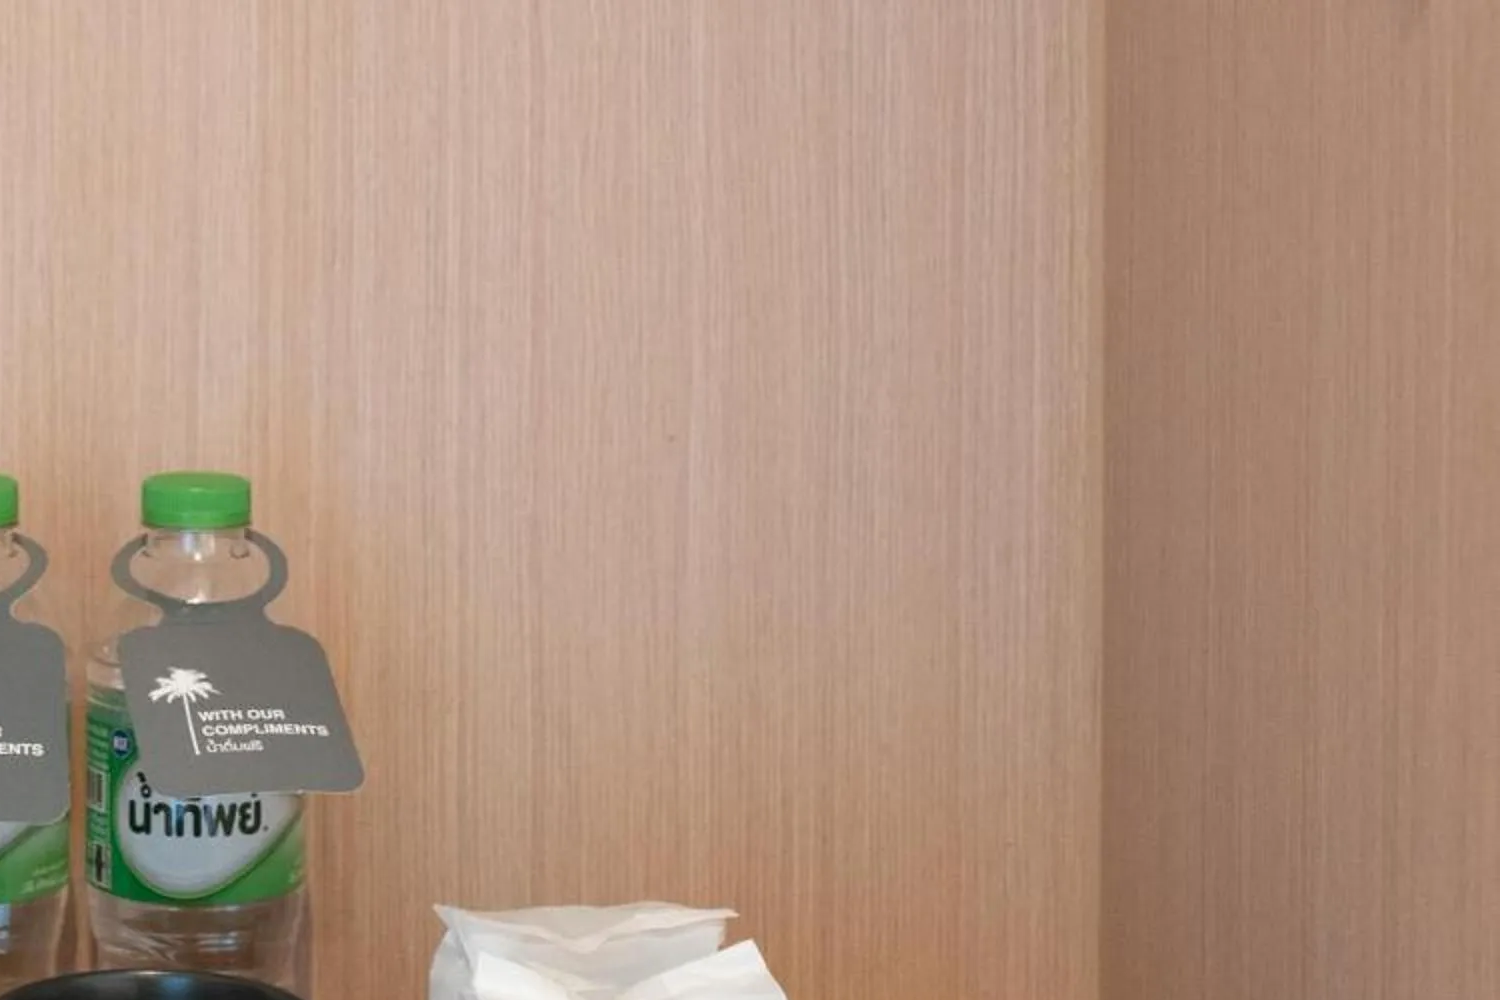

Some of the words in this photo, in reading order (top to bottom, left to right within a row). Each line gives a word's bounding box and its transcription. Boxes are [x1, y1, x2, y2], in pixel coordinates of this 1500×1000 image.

[198, 709, 243, 722] WITH
[247, 708, 286, 721] OUR
[201, 723, 329, 737] COMPLIMENTS
